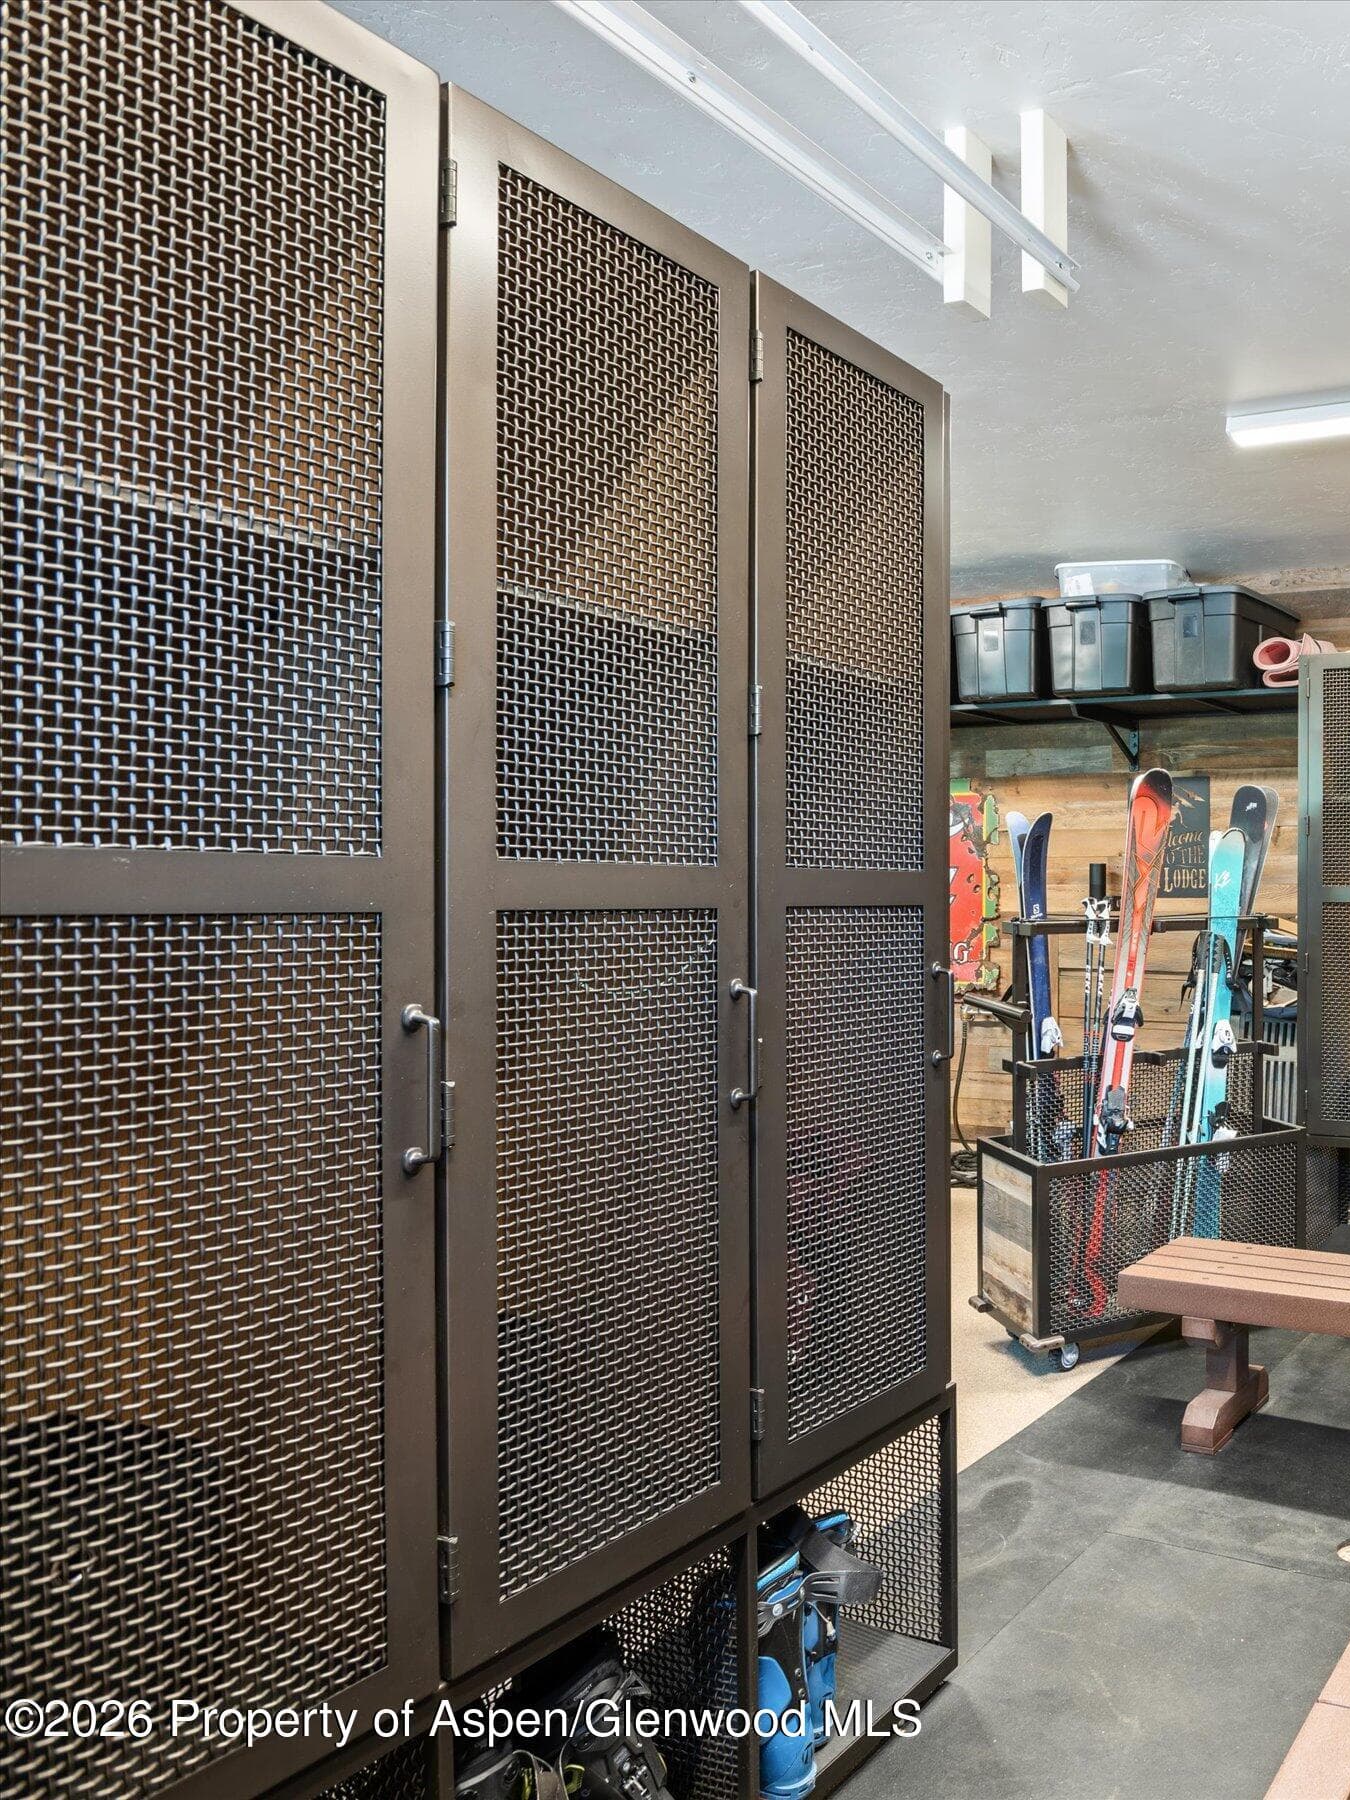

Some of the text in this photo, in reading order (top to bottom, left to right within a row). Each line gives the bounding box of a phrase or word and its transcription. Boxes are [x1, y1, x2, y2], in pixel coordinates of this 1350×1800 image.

[1167, 831, 1203, 848] lcome
[1181, 844, 1206, 865] THE
[1163, 867, 1207, 893] LODGE
